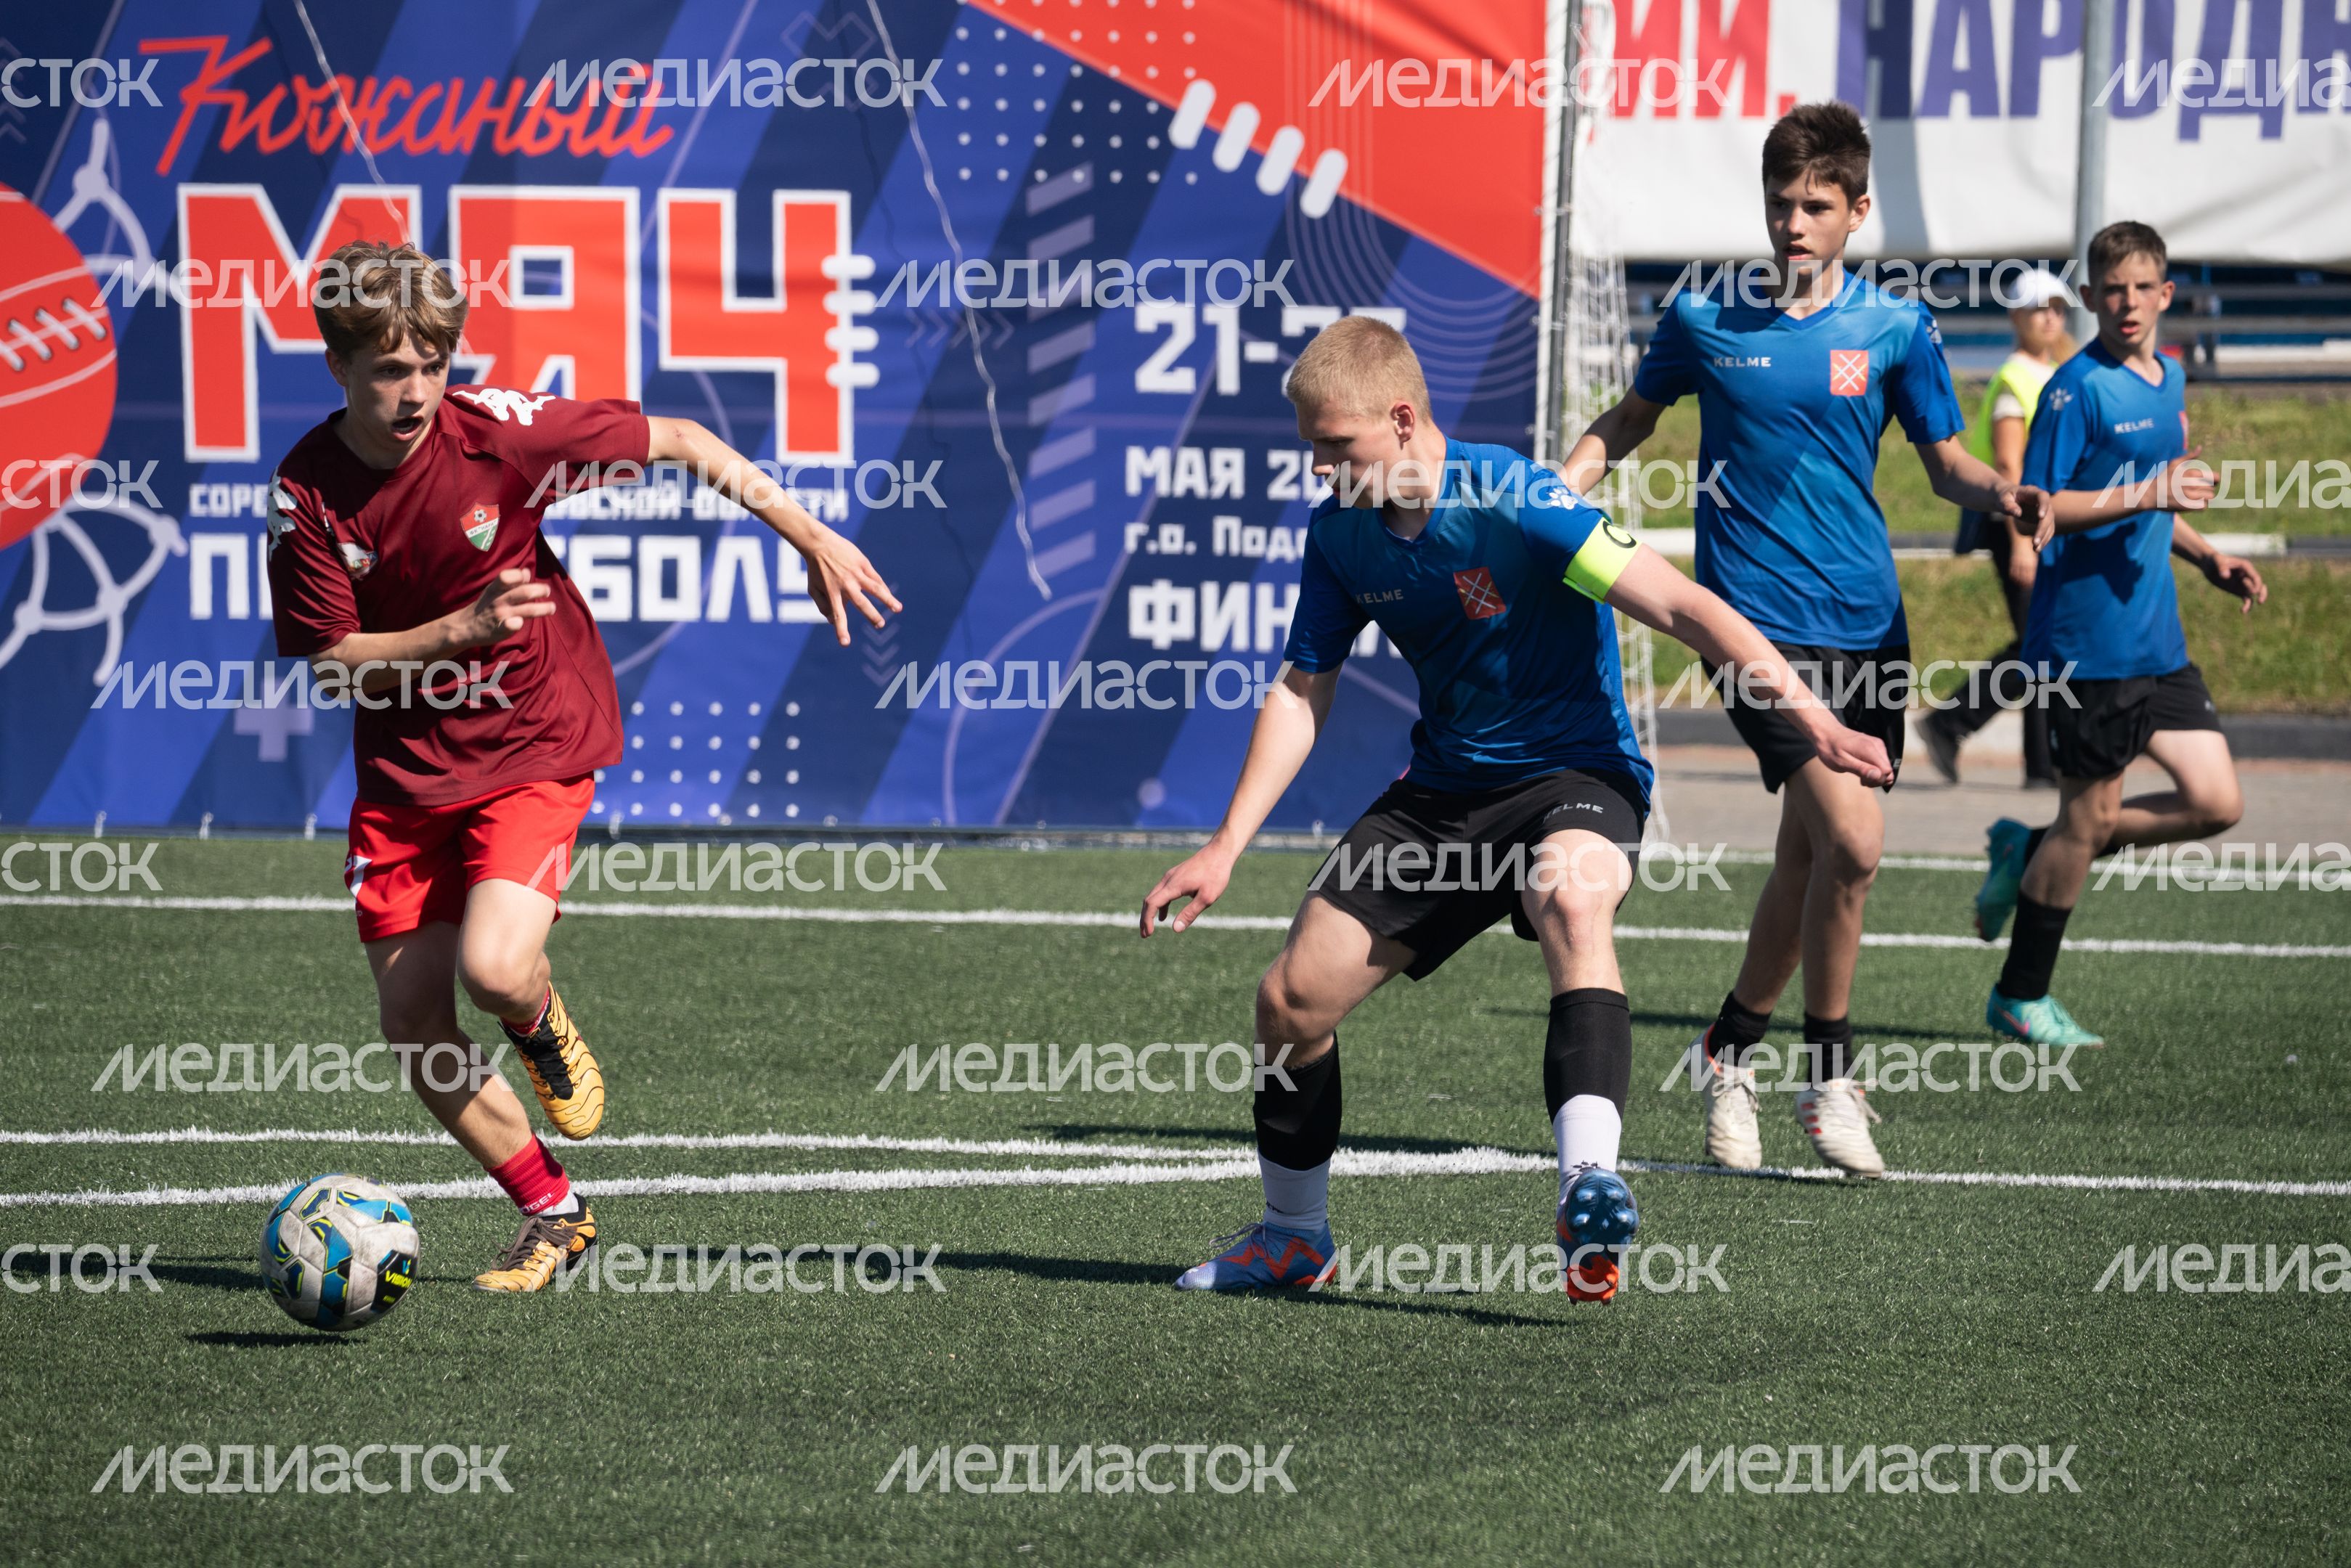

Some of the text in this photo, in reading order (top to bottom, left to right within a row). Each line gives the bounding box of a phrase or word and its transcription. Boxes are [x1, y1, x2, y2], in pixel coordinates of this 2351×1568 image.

[1581, 0, 1797, 121] ИИ.
[139, 35, 675, 177] Кожаный
[177, 183, 858, 467] МЯЧ
[1713, 356, 1772, 368] KELME
[2114, 417, 2154, 435] KELME
[1125, 445, 1246, 500] МАЯ
[190, 483, 269, 518] СОРЕ
[1124, 521, 1197, 556] г.о.
[545, 535, 835, 624] БОЛУ
[1355, 589, 1404, 604] KELME
